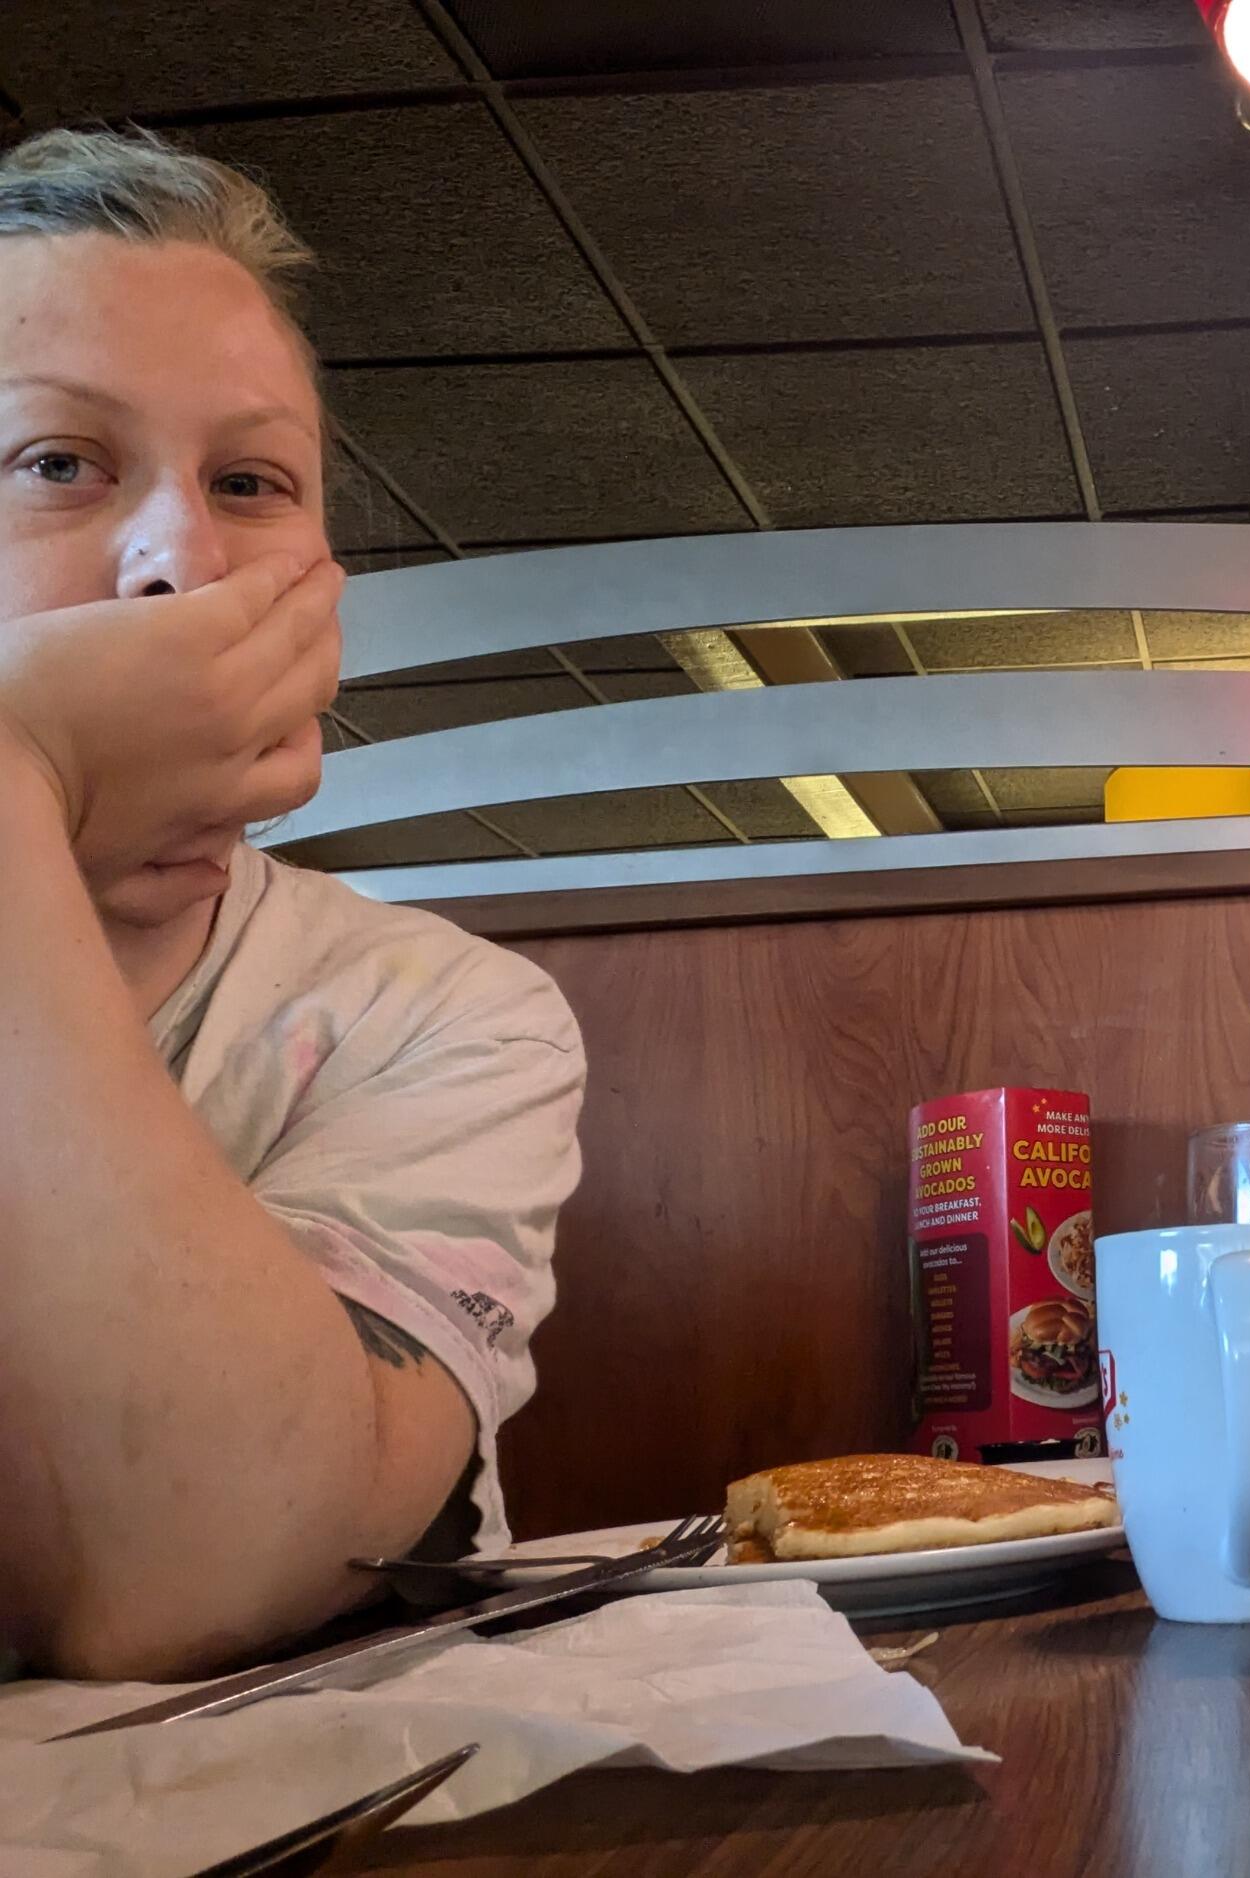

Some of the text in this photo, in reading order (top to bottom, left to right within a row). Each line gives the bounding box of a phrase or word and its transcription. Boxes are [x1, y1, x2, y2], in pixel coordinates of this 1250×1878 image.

[1046, 1111, 1073, 1122] MAKE
[917, 1115, 967, 1141] ADD OUR
[1037, 1123, 1066, 1135] MORE
[1012, 1139, 1091, 1164] CALIFO
[920, 1157, 962, 1179] GROWN
[930, 1216, 946, 1227] AND
[946, 1210, 979, 1225] DINNER
